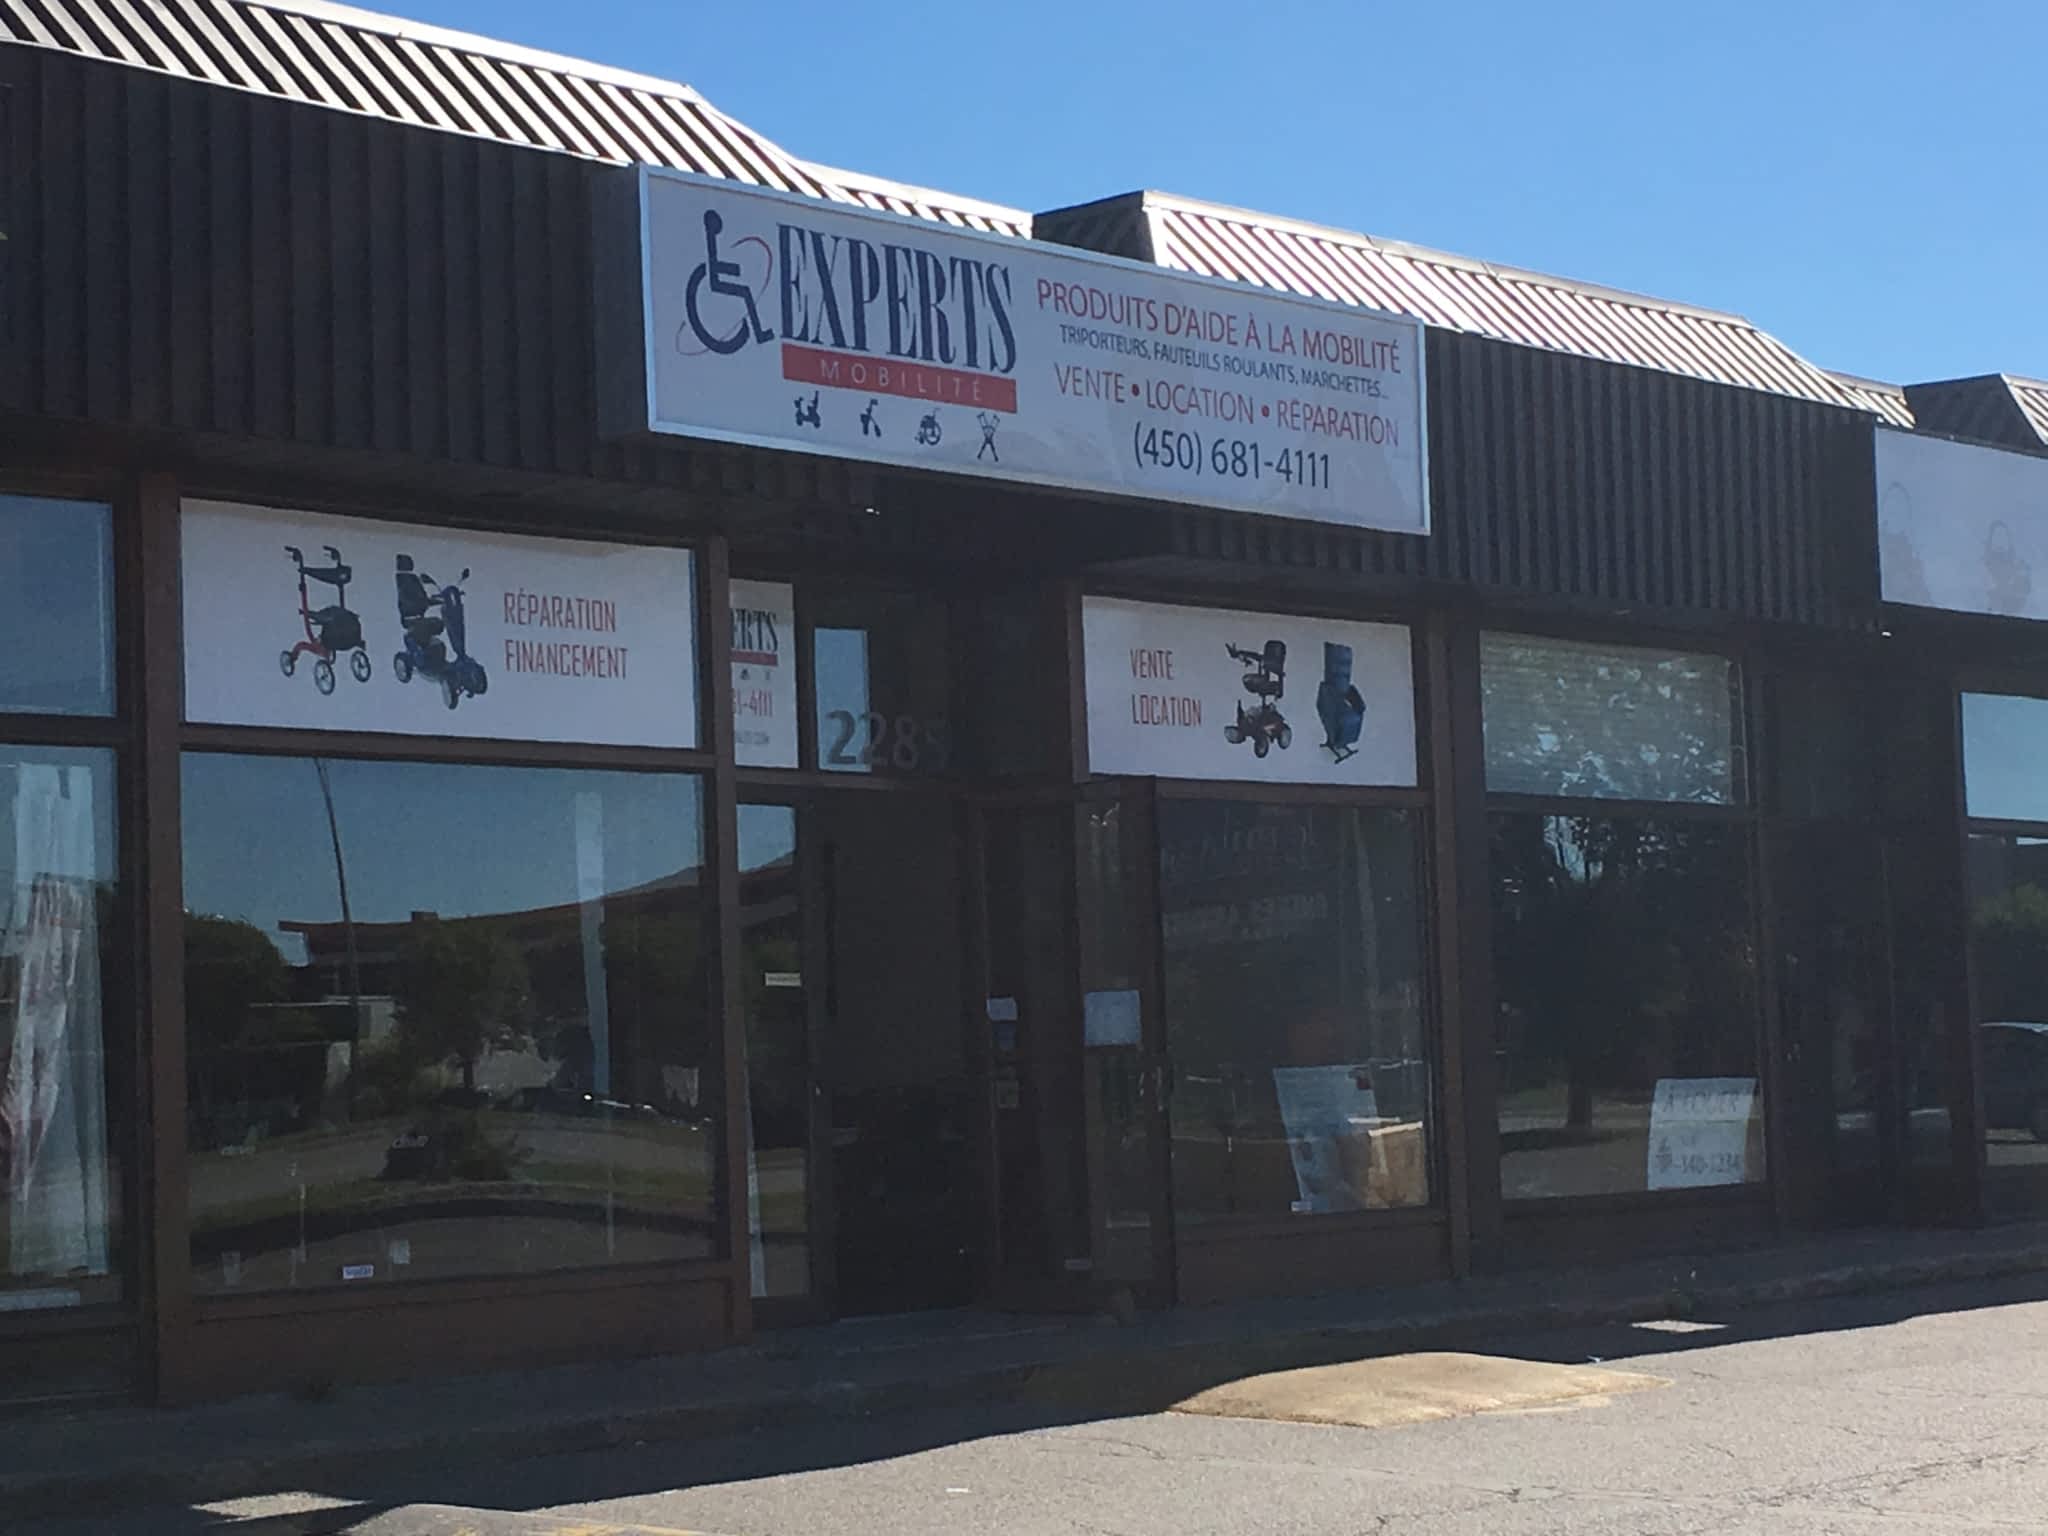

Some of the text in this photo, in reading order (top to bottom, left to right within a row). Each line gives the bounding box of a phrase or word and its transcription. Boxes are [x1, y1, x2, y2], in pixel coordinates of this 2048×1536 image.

[776, 222, 1017, 374] EXPERTS
[1037, 278, 1401, 375] PRODUITS D'AIDE À LA MOBILITÉ
[820, 357, 983, 402] MOBILITÉ
[1059, 324, 1152, 361] TRIPORTEURS,
[1154, 342, 1220, 371] FAUTEUILS
[1224, 357, 1299, 386] ROULANTS,
[1055, 362, 1399, 448] VENTE LOCATION RÉPARATION
[1134, 420, 1330, 489] (450) 681-4111
[503, 587, 616, 633] RÉPARATION
[504, 639, 629, 680] FINANCEMENT
[1129, 648, 1175, 681] VENTE
[1131, 694, 1202, 728] LOCATION
